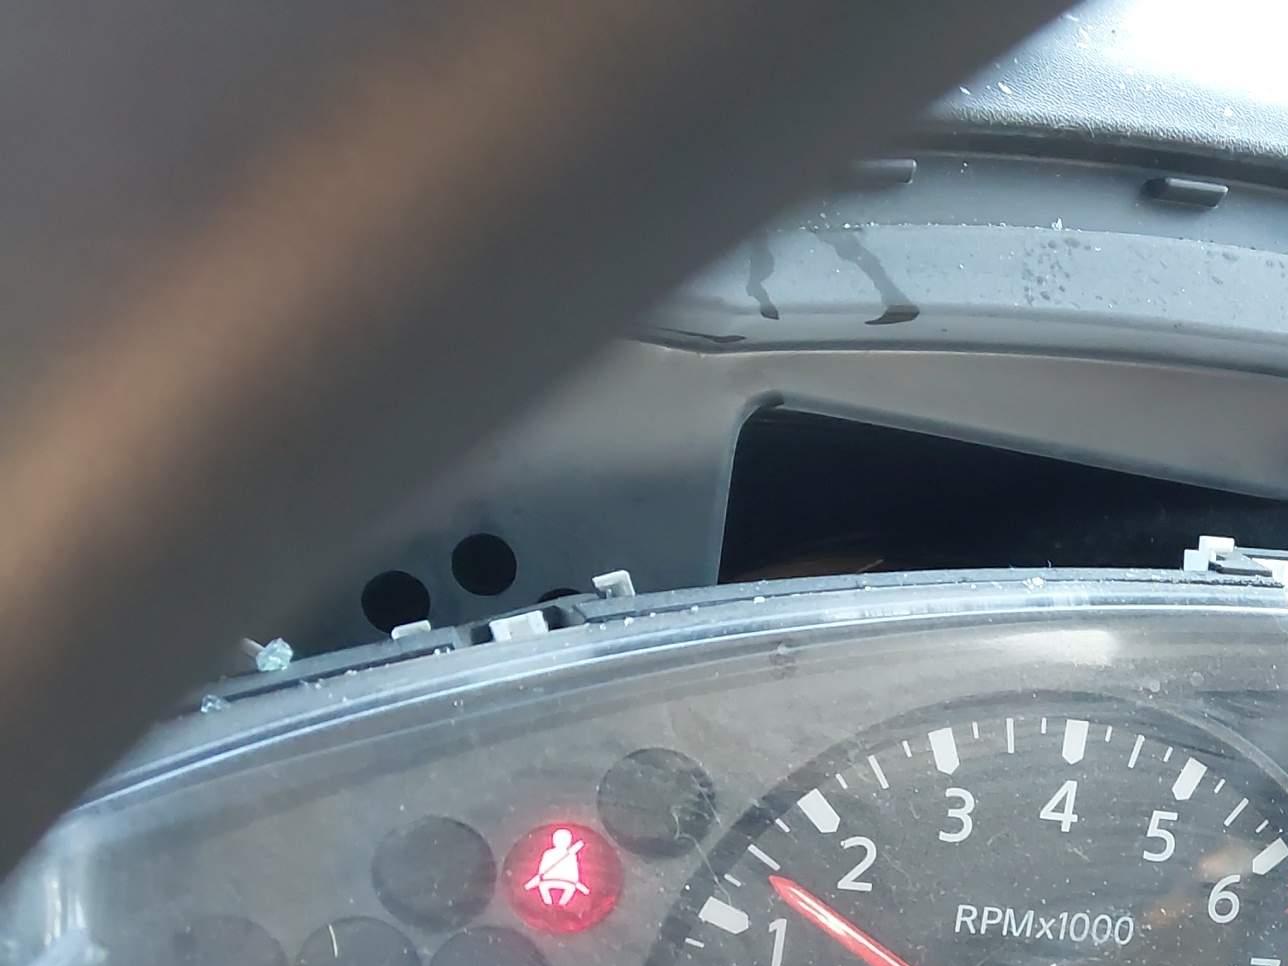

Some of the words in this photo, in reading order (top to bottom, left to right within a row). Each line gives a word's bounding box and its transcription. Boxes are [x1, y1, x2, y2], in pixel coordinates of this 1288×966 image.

[938, 788, 976, 842] 3
[1040, 781, 1078, 832] 4
[1141, 811, 1178, 862] 5
[836, 836, 878, 891] 2
[1207, 874, 1241, 923] 6
[954, 904, 1135, 946] RPMx1000
